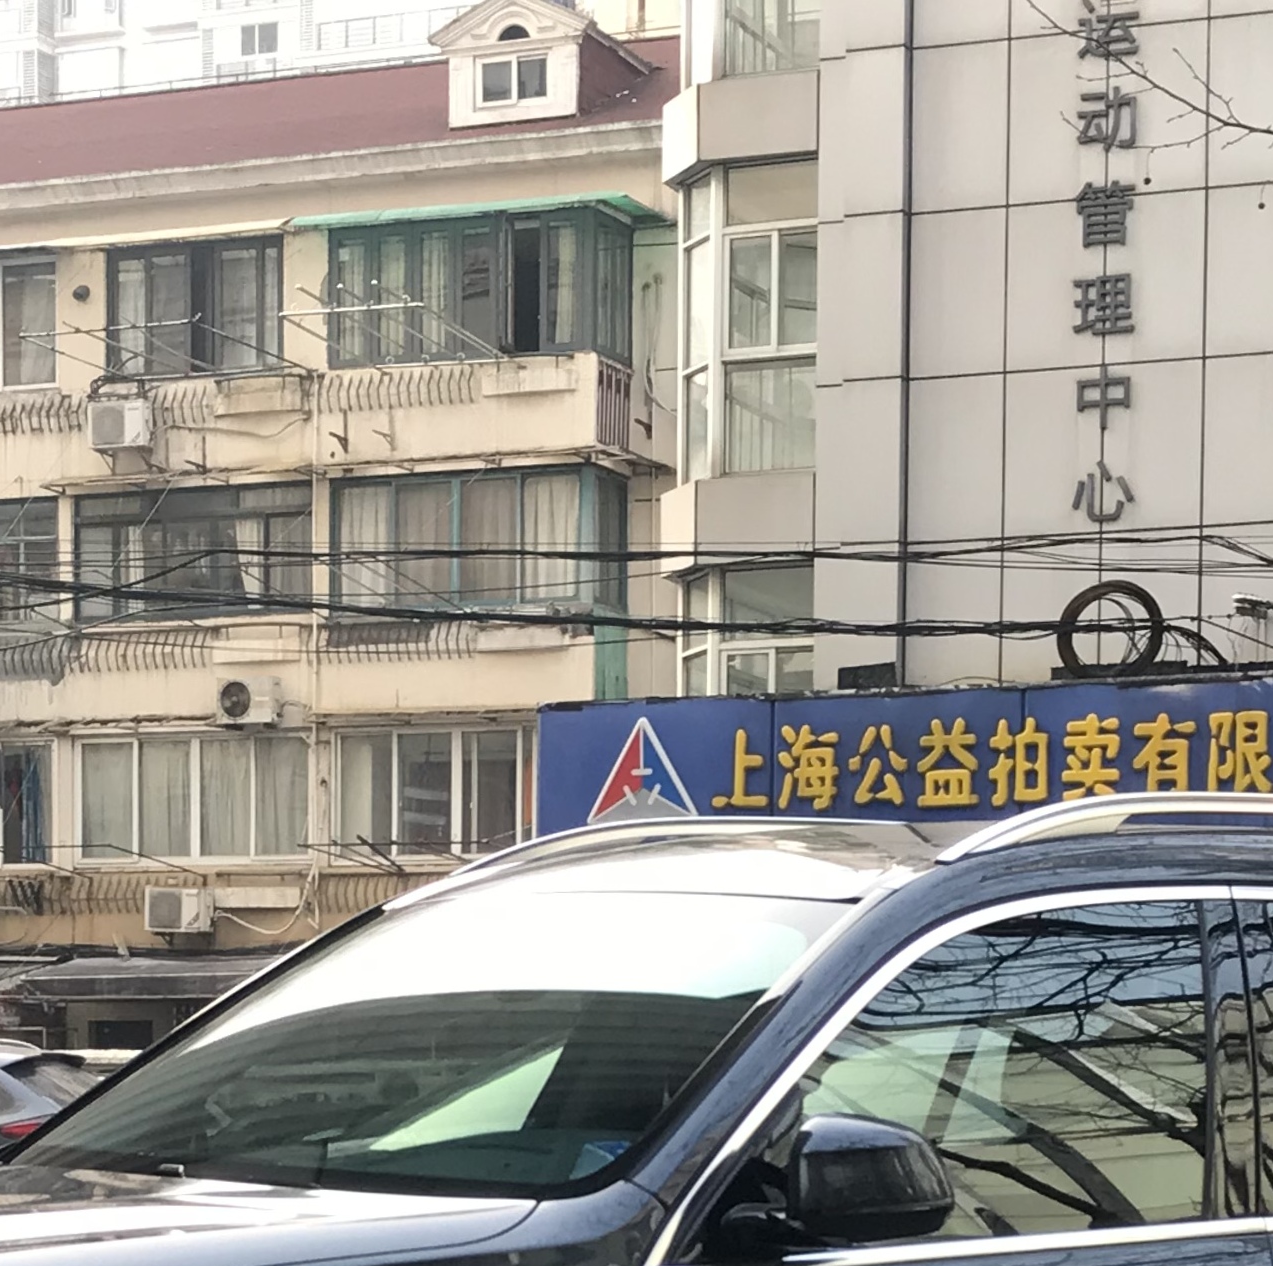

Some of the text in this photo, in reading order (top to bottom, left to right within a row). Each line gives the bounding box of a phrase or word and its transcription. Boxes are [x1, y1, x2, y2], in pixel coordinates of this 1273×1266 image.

[1072, 0, 1140, 522] 运动管理中心
